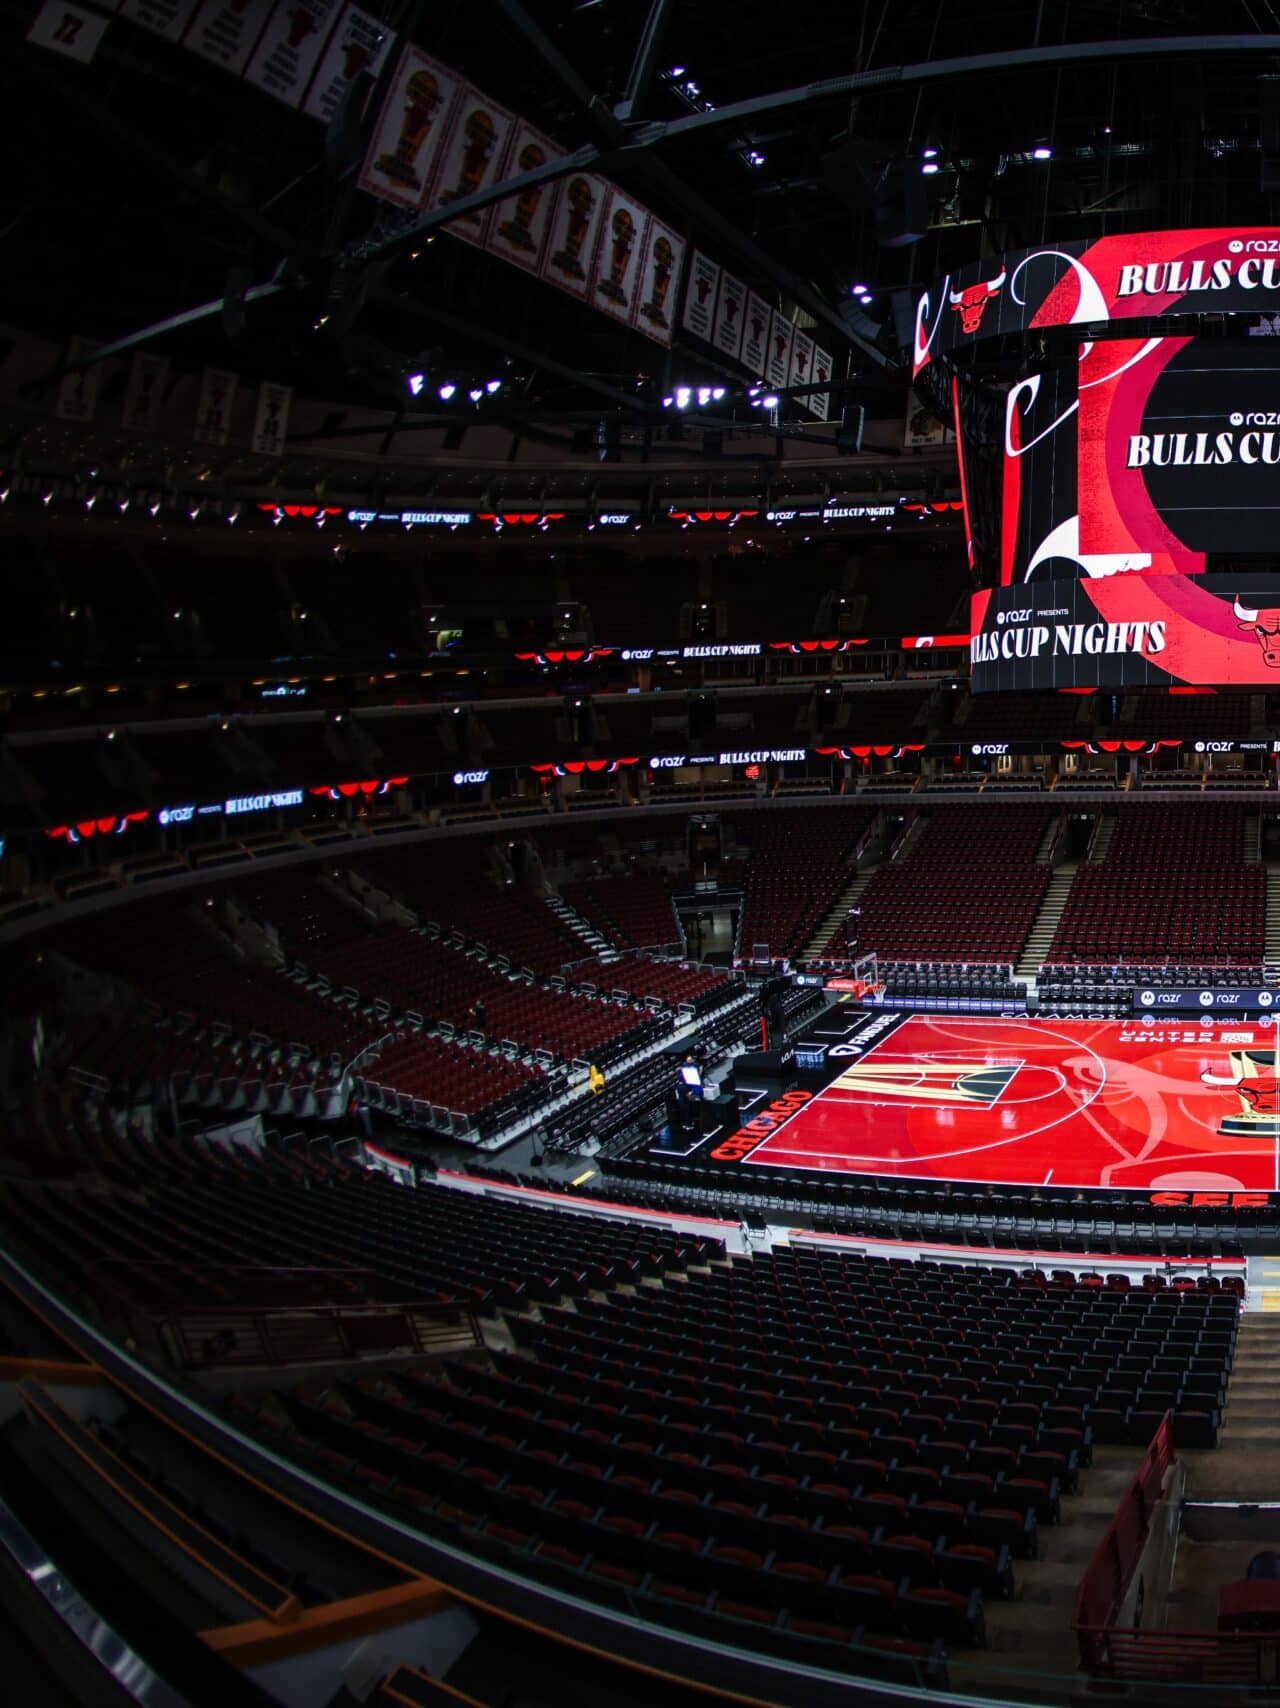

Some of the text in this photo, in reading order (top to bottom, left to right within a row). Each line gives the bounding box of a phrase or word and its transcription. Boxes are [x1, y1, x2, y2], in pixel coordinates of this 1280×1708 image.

[1116, 260, 1232, 297] BULLS
[1126, 432, 1233, 467] BULLS
[824, 509, 848, 517] BULLS
[849, 508, 866, 516] CUP
[867, 507, 894, 515] NIGHTS
[1006, 608, 1069, 622] razr PRESENTS
[1002, 627, 1049, 659] CUP
[1052, 621, 1166, 656] NIGHTS
[631, 650, 653, 659] razr
[684, 647, 710, 656] BULLS
[710, 646, 728, 655] CUP
[729, 645, 760, 654] NIGHTS
[983, 745, 1008, 754] razr
[1207, 742, 1234, 751] razr
[660, 757, 685, 766] razr
[720, 753, 749, 764] BULLS
[751, 752, 770, 762] CUP
[771, 750, 805, 761] NIGHTS
[464, 771, 488, 782] razr
[1158, 994, 1181, 1003] razr
[1217, 994, 1240, 1003] razr
[1001, 1012, 1117, 1020] CALAMOS
[848, 1012, 902, 1045] FANDUEL
[710, 1090, 813, 1161] CHICAGO
